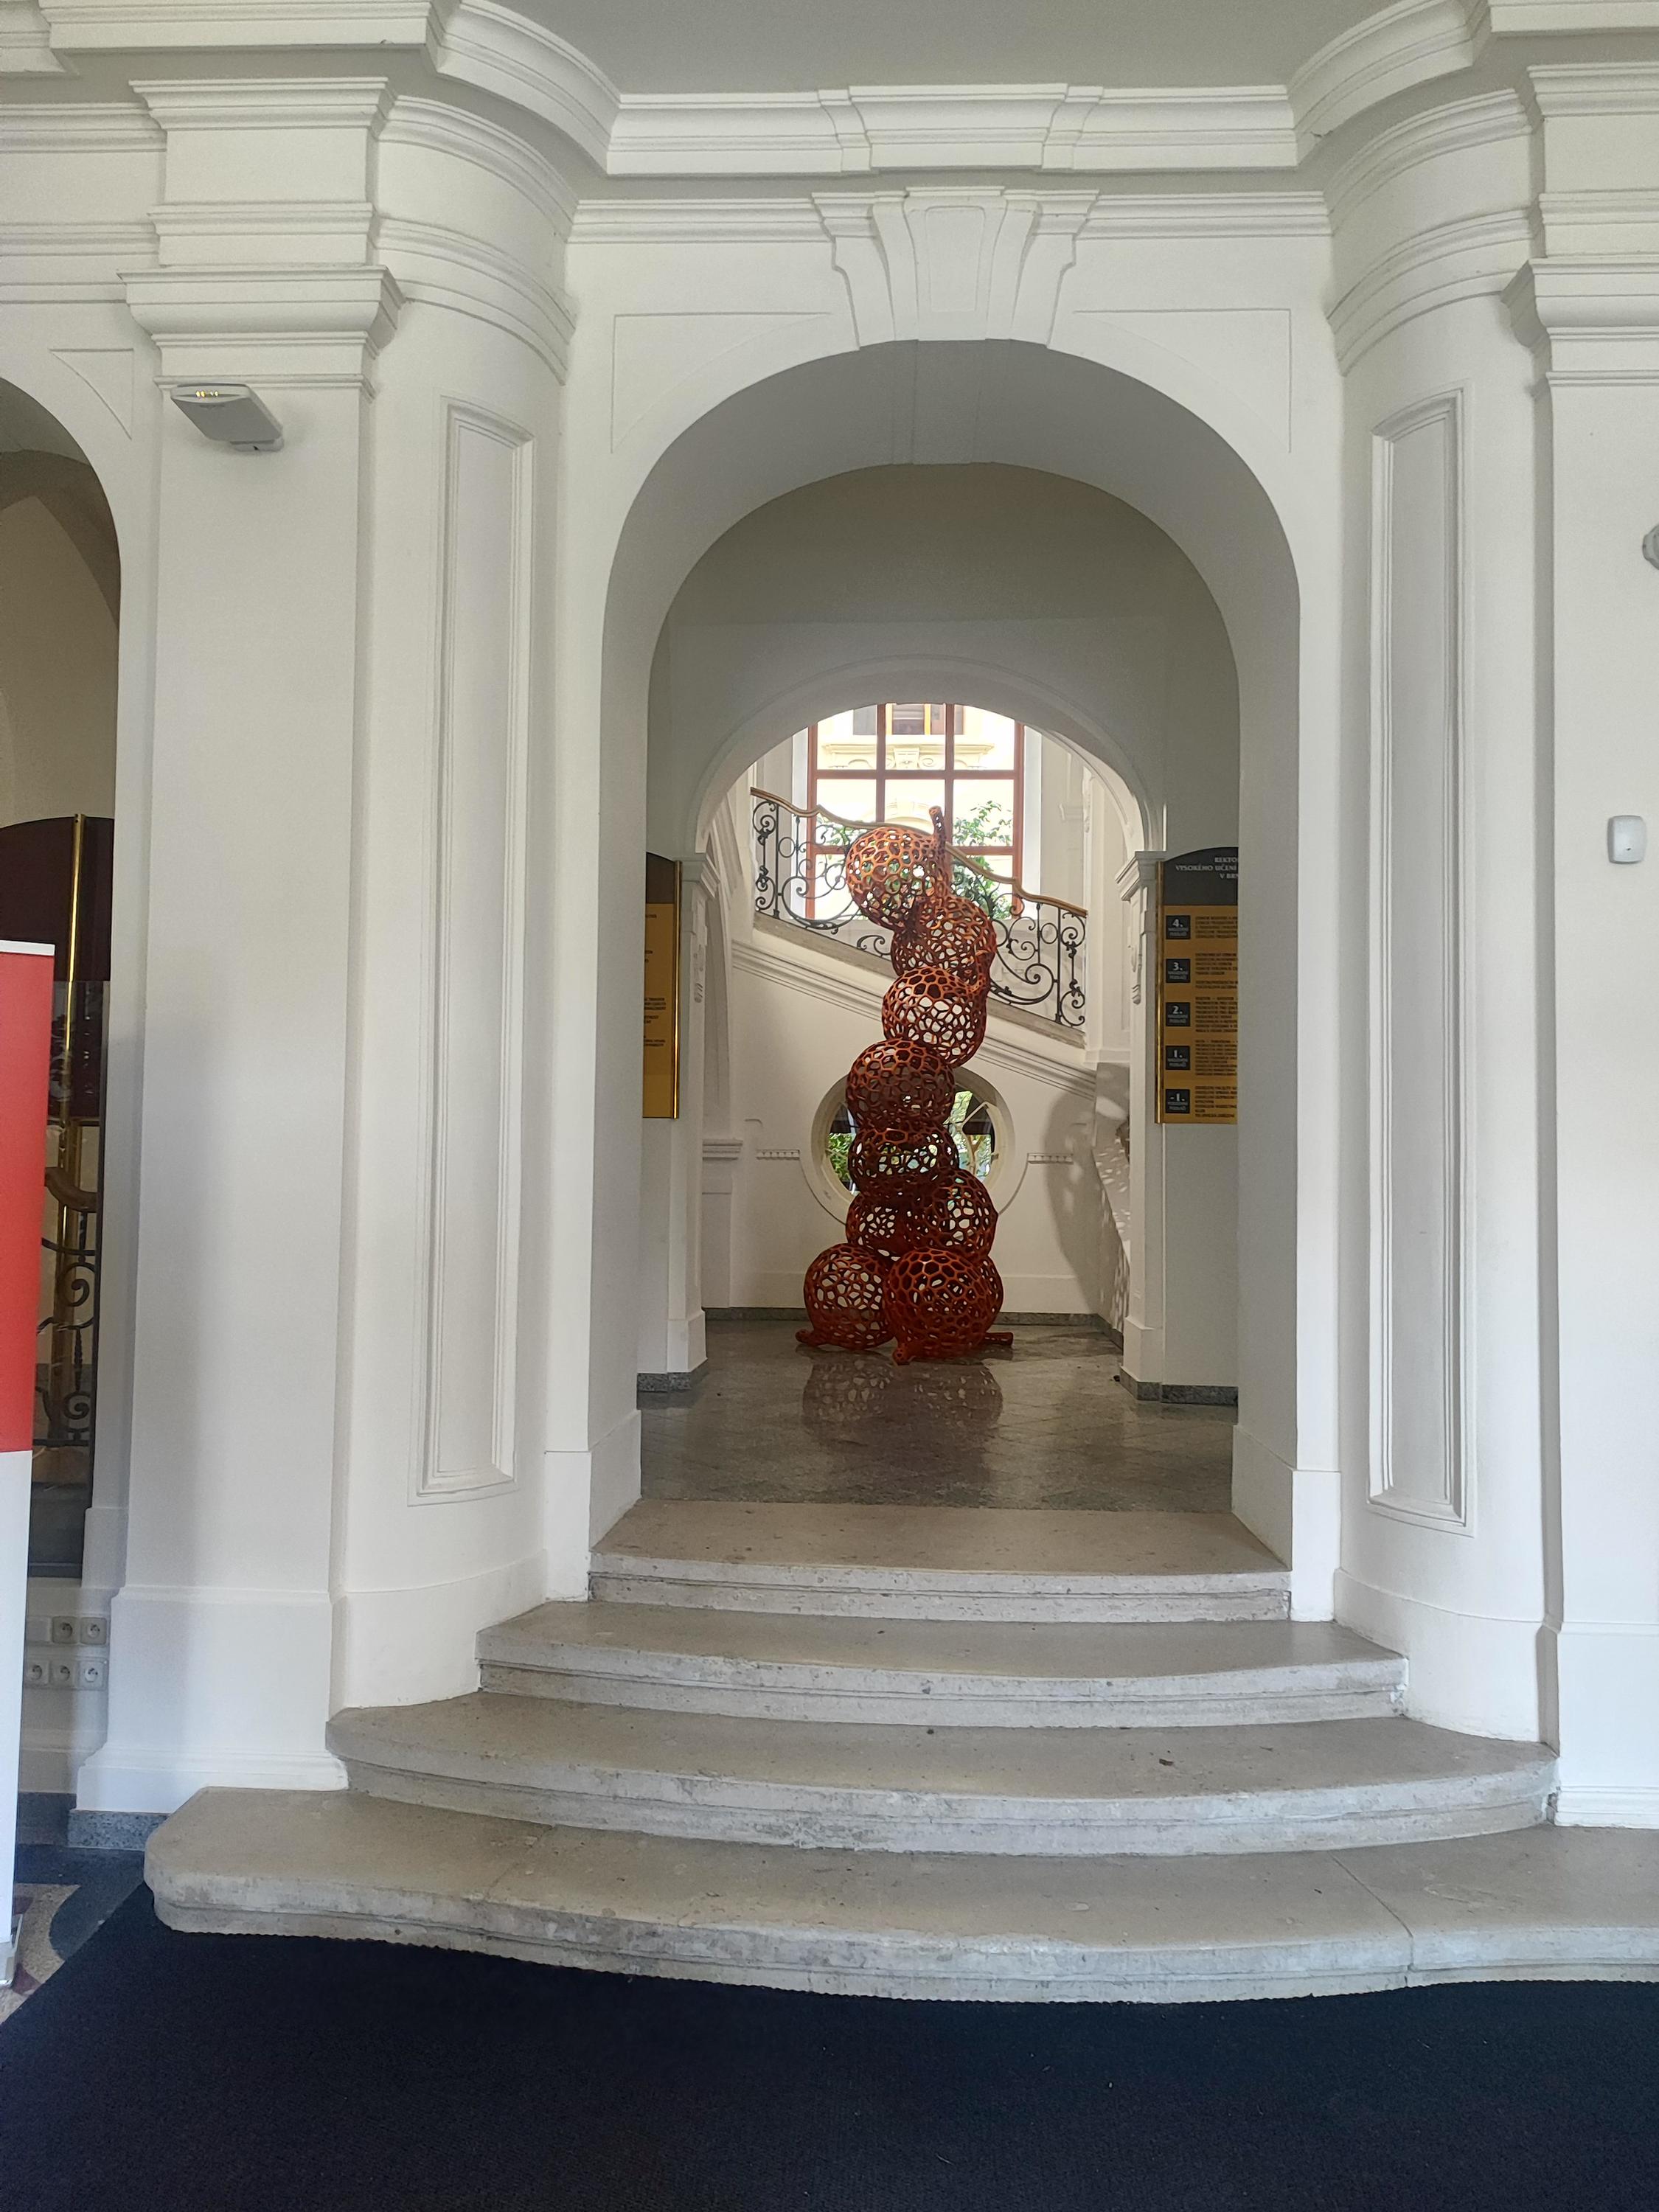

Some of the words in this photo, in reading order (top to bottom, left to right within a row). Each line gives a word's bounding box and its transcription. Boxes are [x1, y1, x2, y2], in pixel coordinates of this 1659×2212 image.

[1172, 919, 1183, 928] 4.
[1173, 962, 1183, 970] 3.
[1172, 1006, 1183, 1014] 2.
